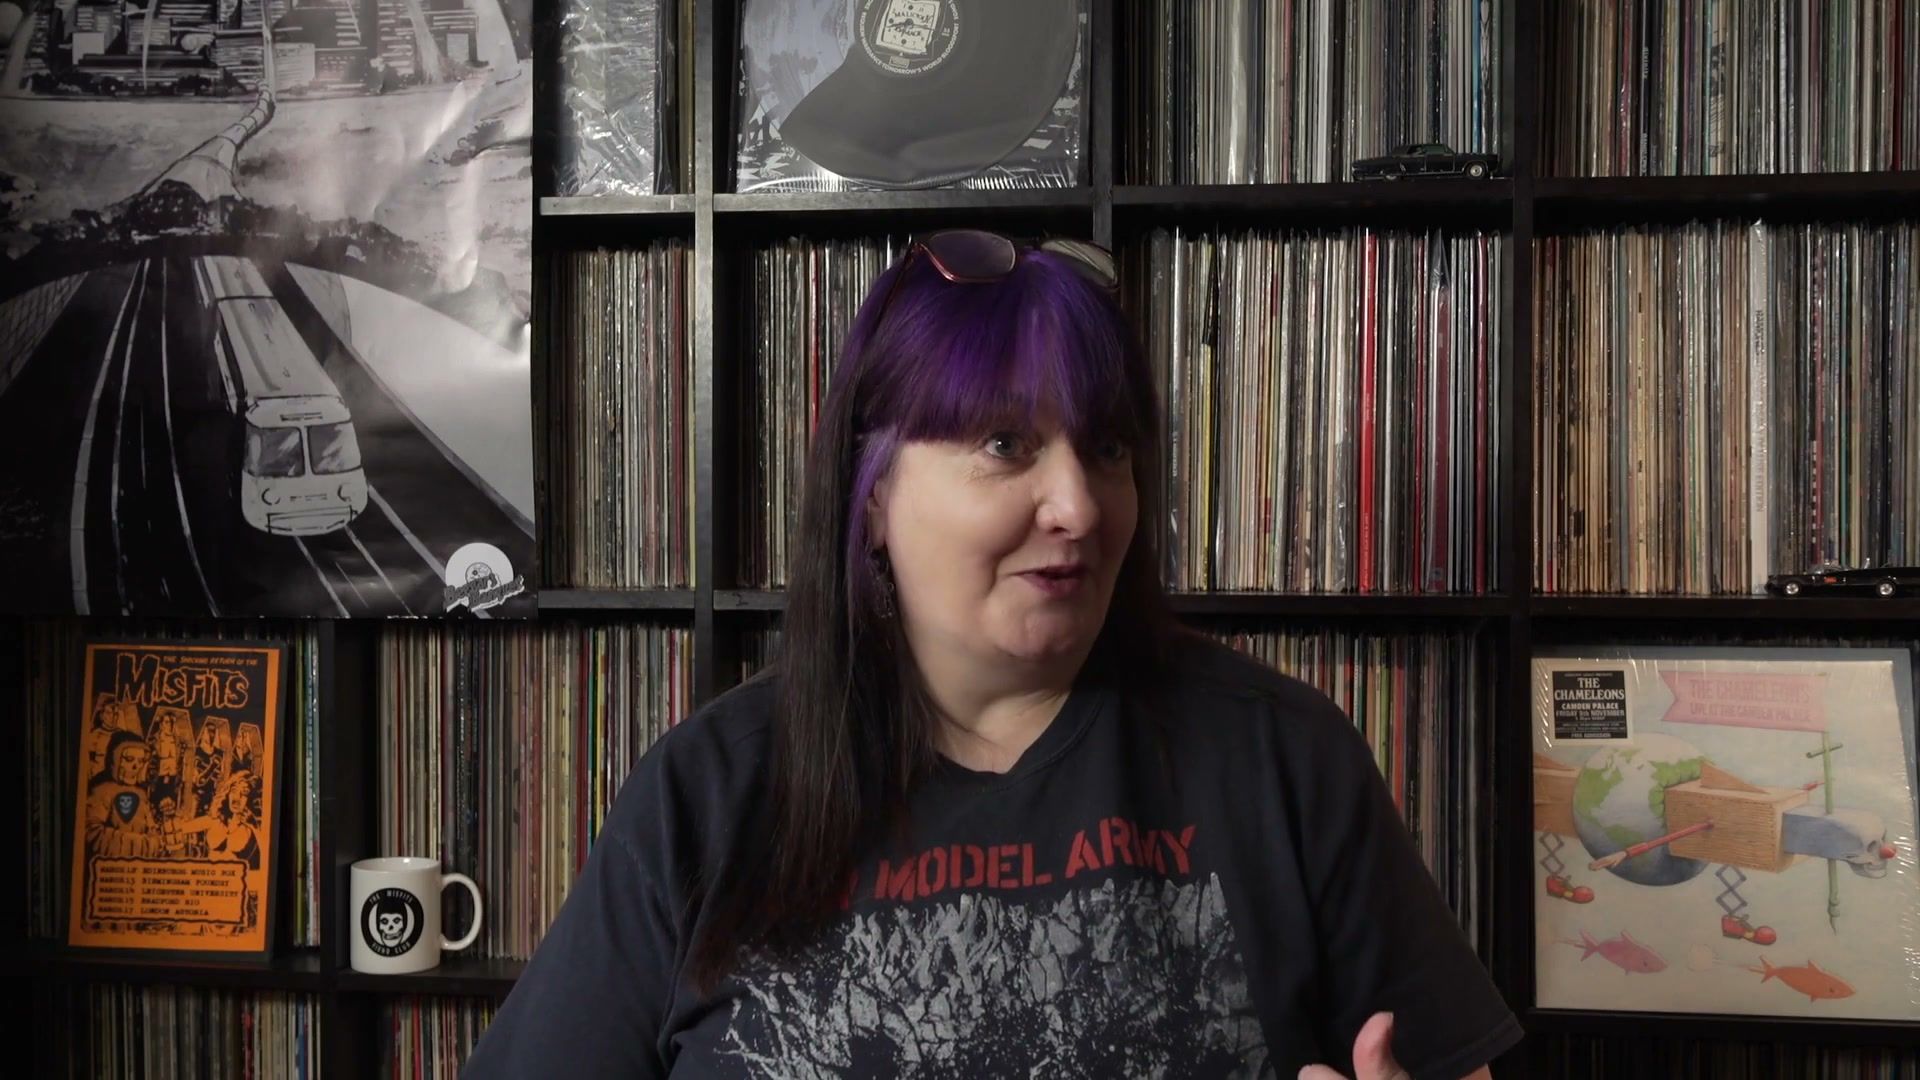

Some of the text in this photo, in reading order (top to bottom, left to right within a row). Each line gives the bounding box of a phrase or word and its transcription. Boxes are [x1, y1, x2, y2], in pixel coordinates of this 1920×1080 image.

[1576, 677, 1601, 688] THE
[1554, 689, 1625, 700] CHAMELEONS
[1689, 678, 1713, 700] THE
[1561, 702, 1619, 710] CAMDEN PALACE
[875, 842, 1052, 903] MODEL
[1064, 816, 1197, 878] ARMY
